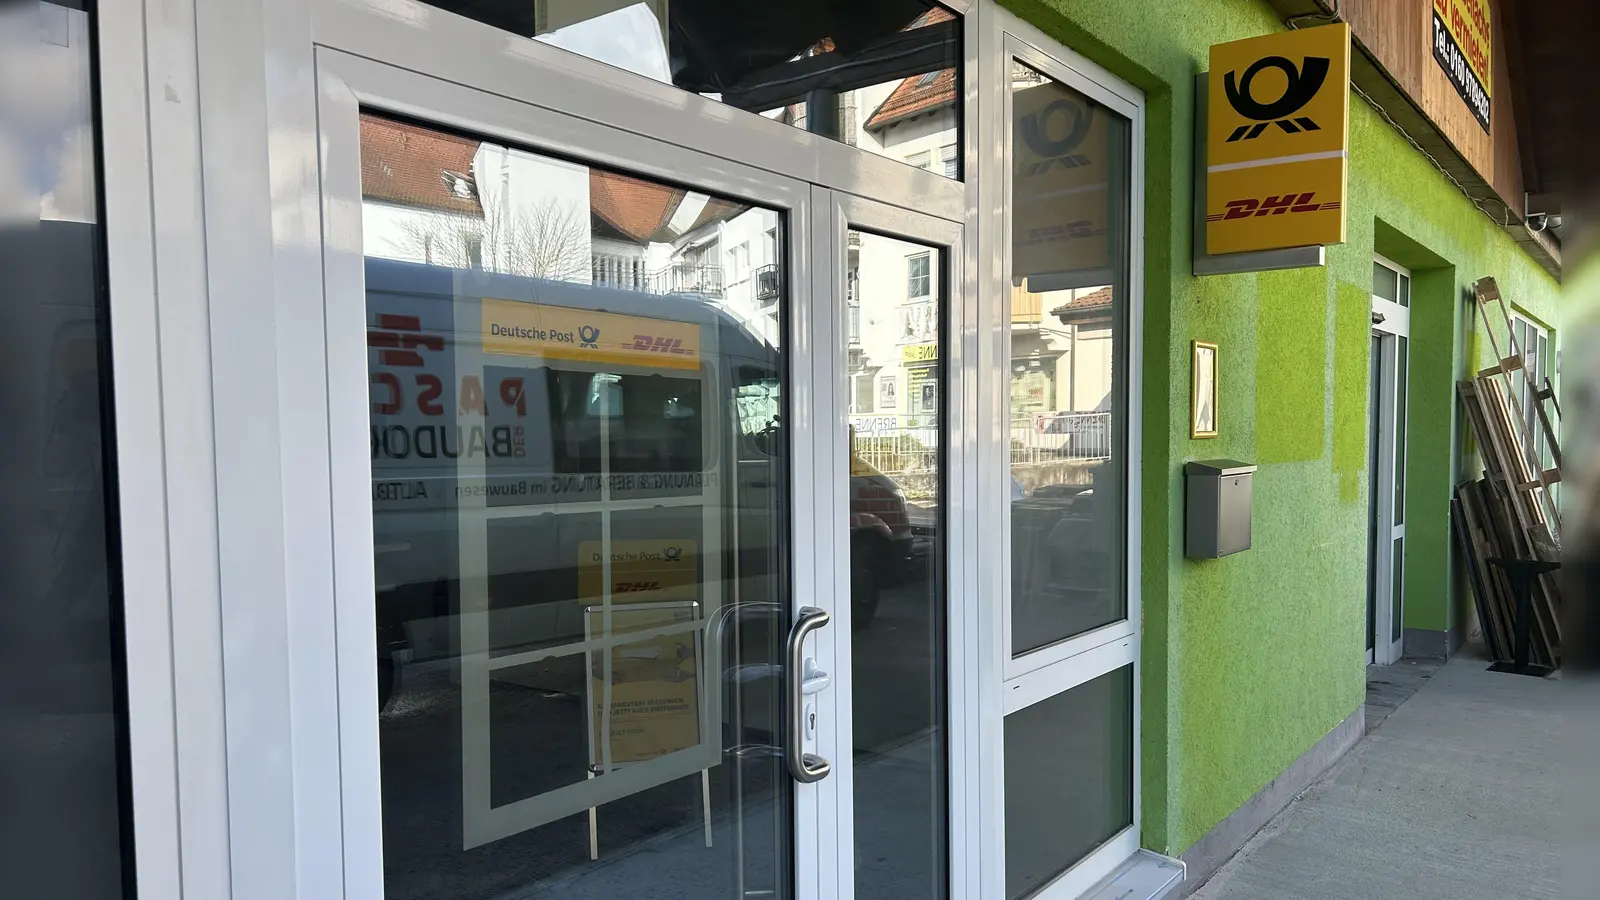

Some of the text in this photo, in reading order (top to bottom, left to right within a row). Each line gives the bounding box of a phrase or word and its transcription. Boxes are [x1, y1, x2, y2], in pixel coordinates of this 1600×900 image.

[1223, 192, 1321, 220] DHL
[491, 322, 688, 355] Deutsche Post DHL
[640, 551, 661, 561] Post
[614, 582, 663, 593] DHL
